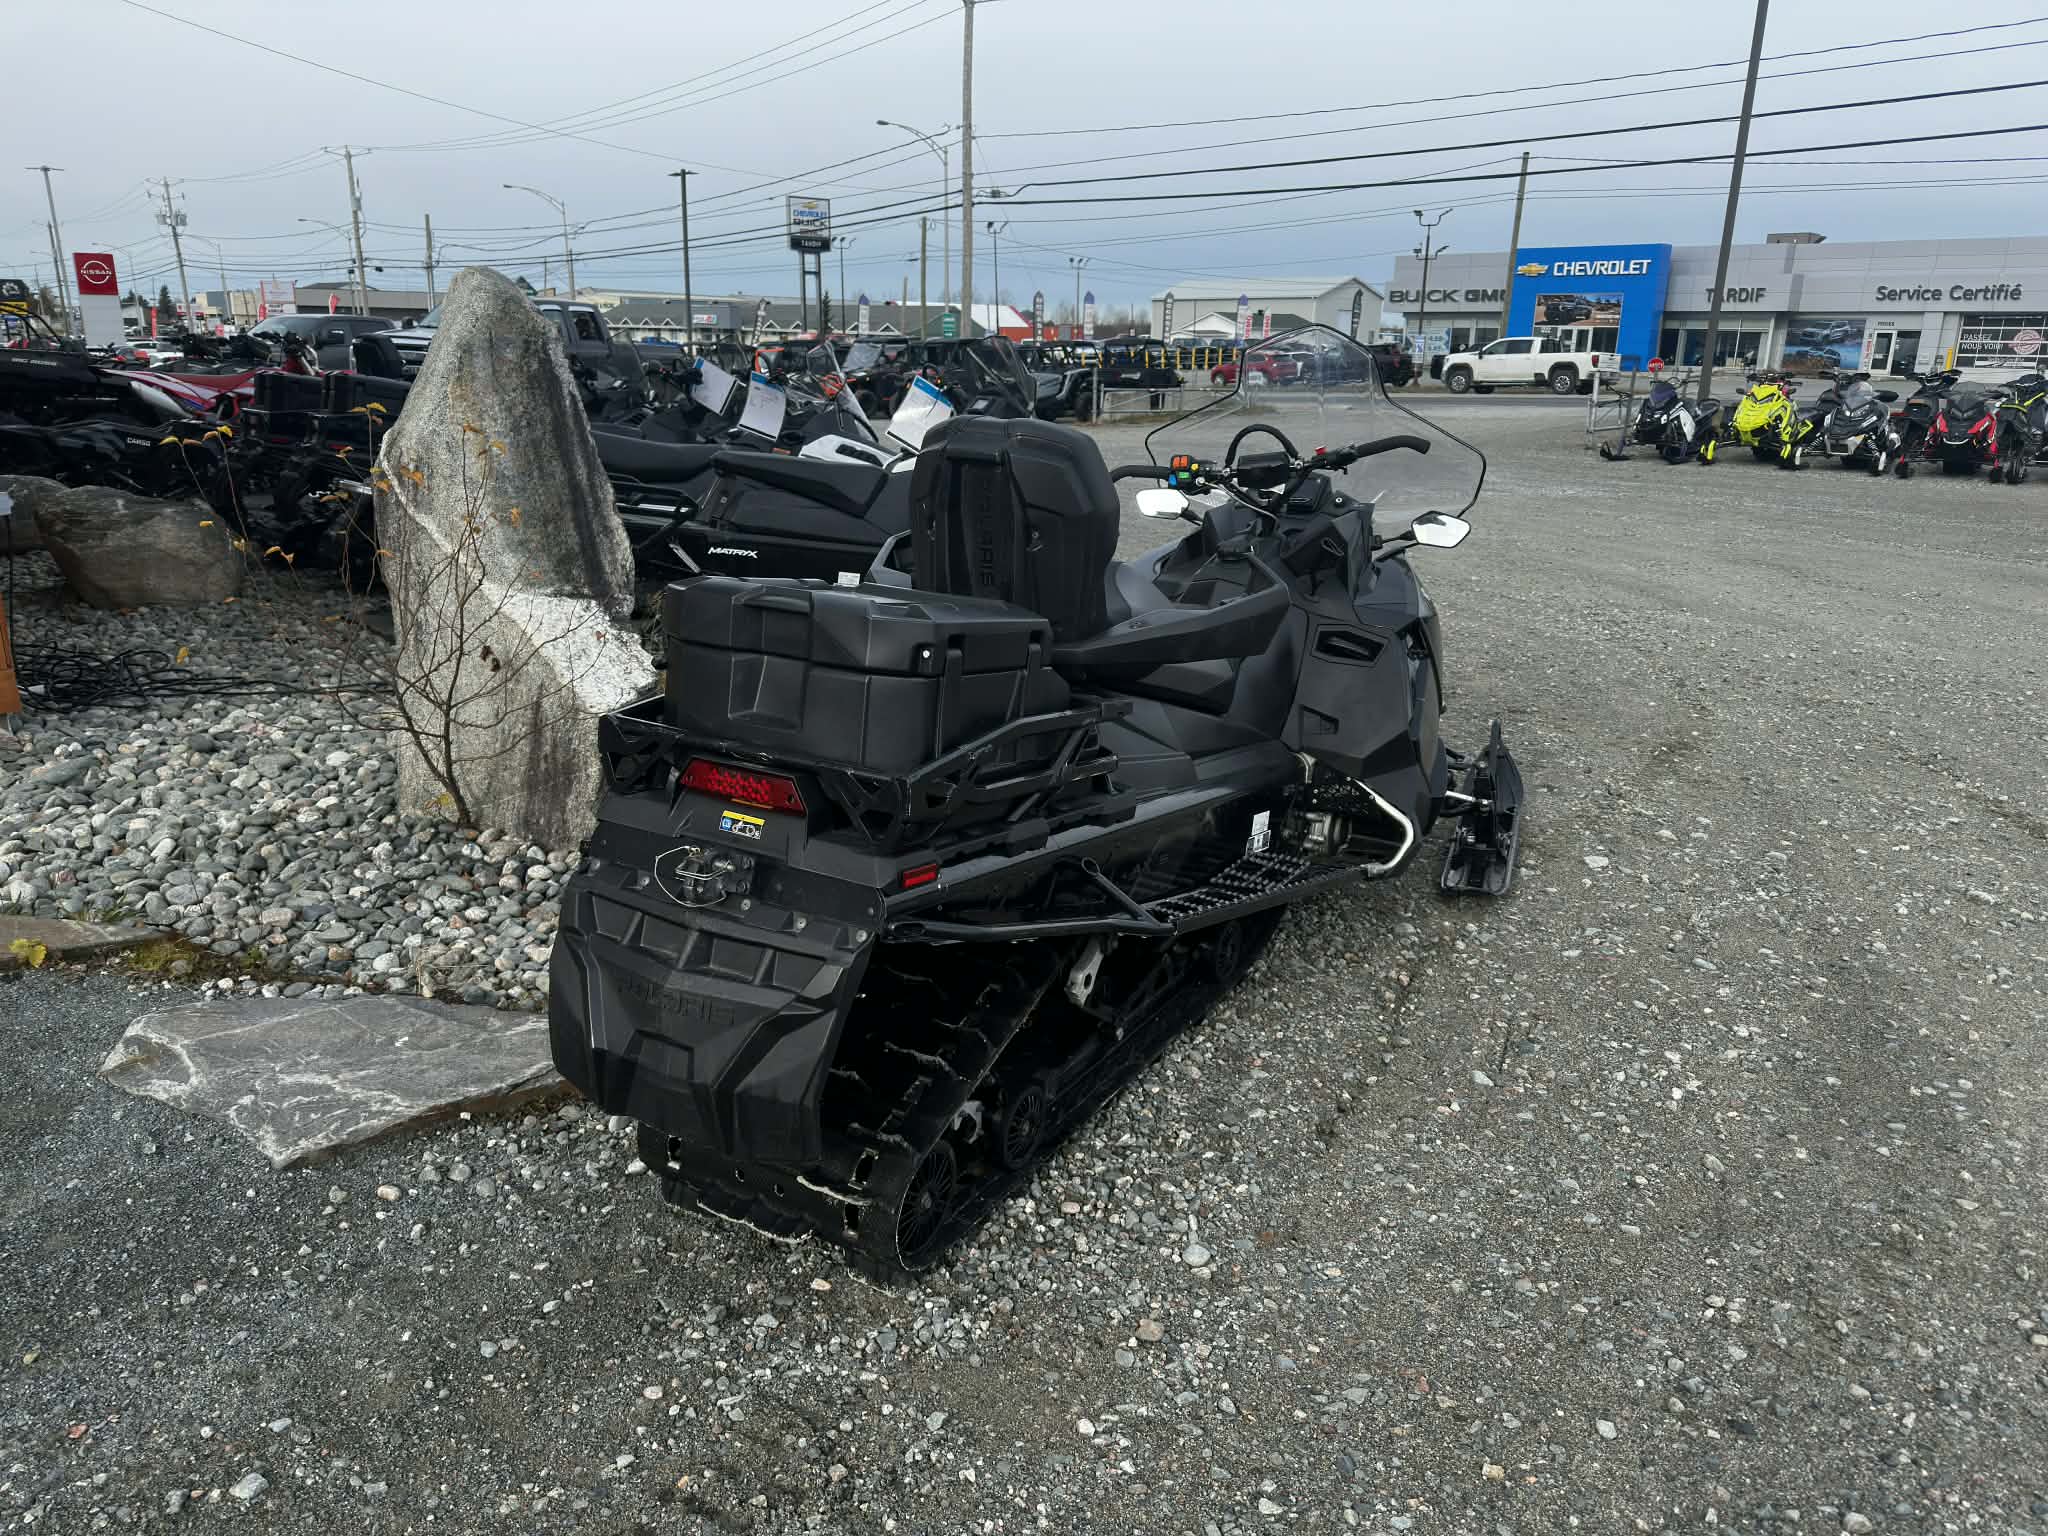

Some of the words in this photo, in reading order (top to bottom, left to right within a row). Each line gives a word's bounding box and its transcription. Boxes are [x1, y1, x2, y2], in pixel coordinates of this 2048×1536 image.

[1553, 259, 1652, 276] CHEVROLET
[1389, 289, 1460, 303] BUCK
[1705, 287, 1767, 303] TRDIF
[1875, 285, 1943, 301] Service
[1949, 284, 2022, 301] Certifié
[1962, 333, 1993, 342] PASSEZ
[1961, 342, 1982, 350] NOUS
[707, 546, 759, 559] MATRYX
